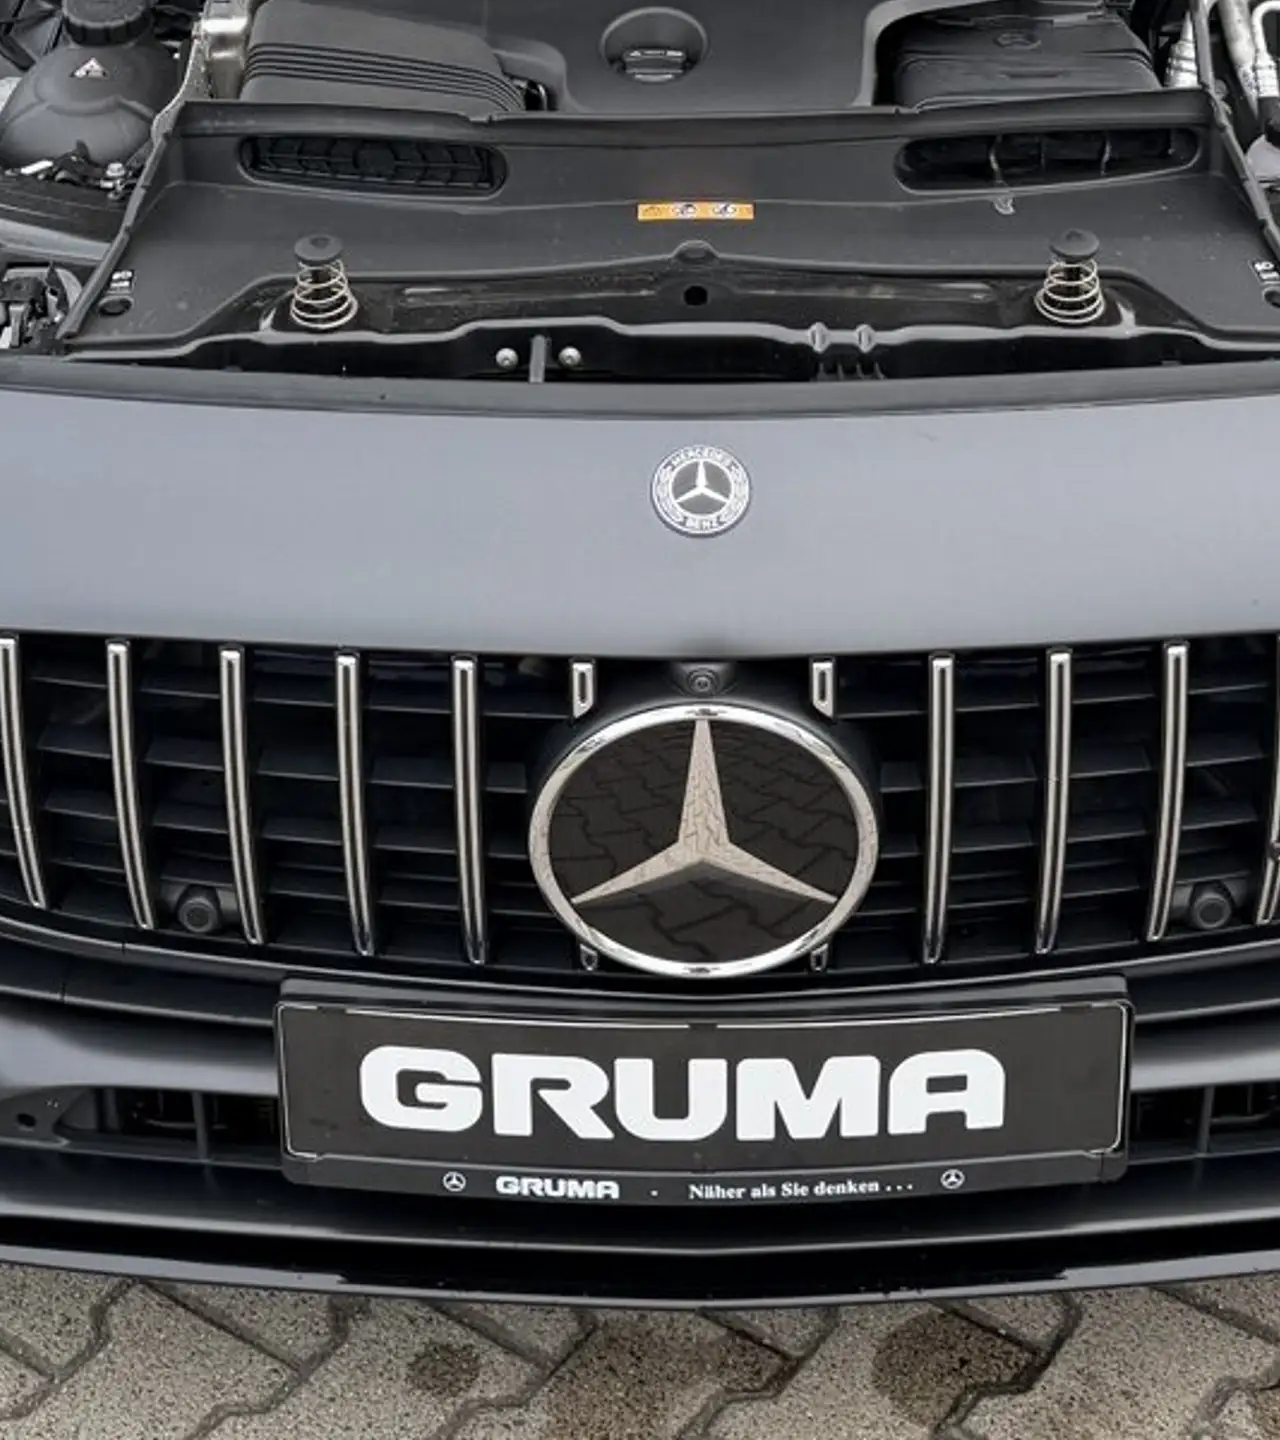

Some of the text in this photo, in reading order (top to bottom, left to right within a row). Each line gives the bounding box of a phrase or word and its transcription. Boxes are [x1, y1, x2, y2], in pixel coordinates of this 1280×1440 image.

[359, 1045, 1006, 1141] GRUMA
[495, 1175, 620, 1200] GRUMA
[688, 1183, 746, 1201] Näher
[751, 1182, 776, 1200] als
[780, 1181, 808, 1198] Sie
